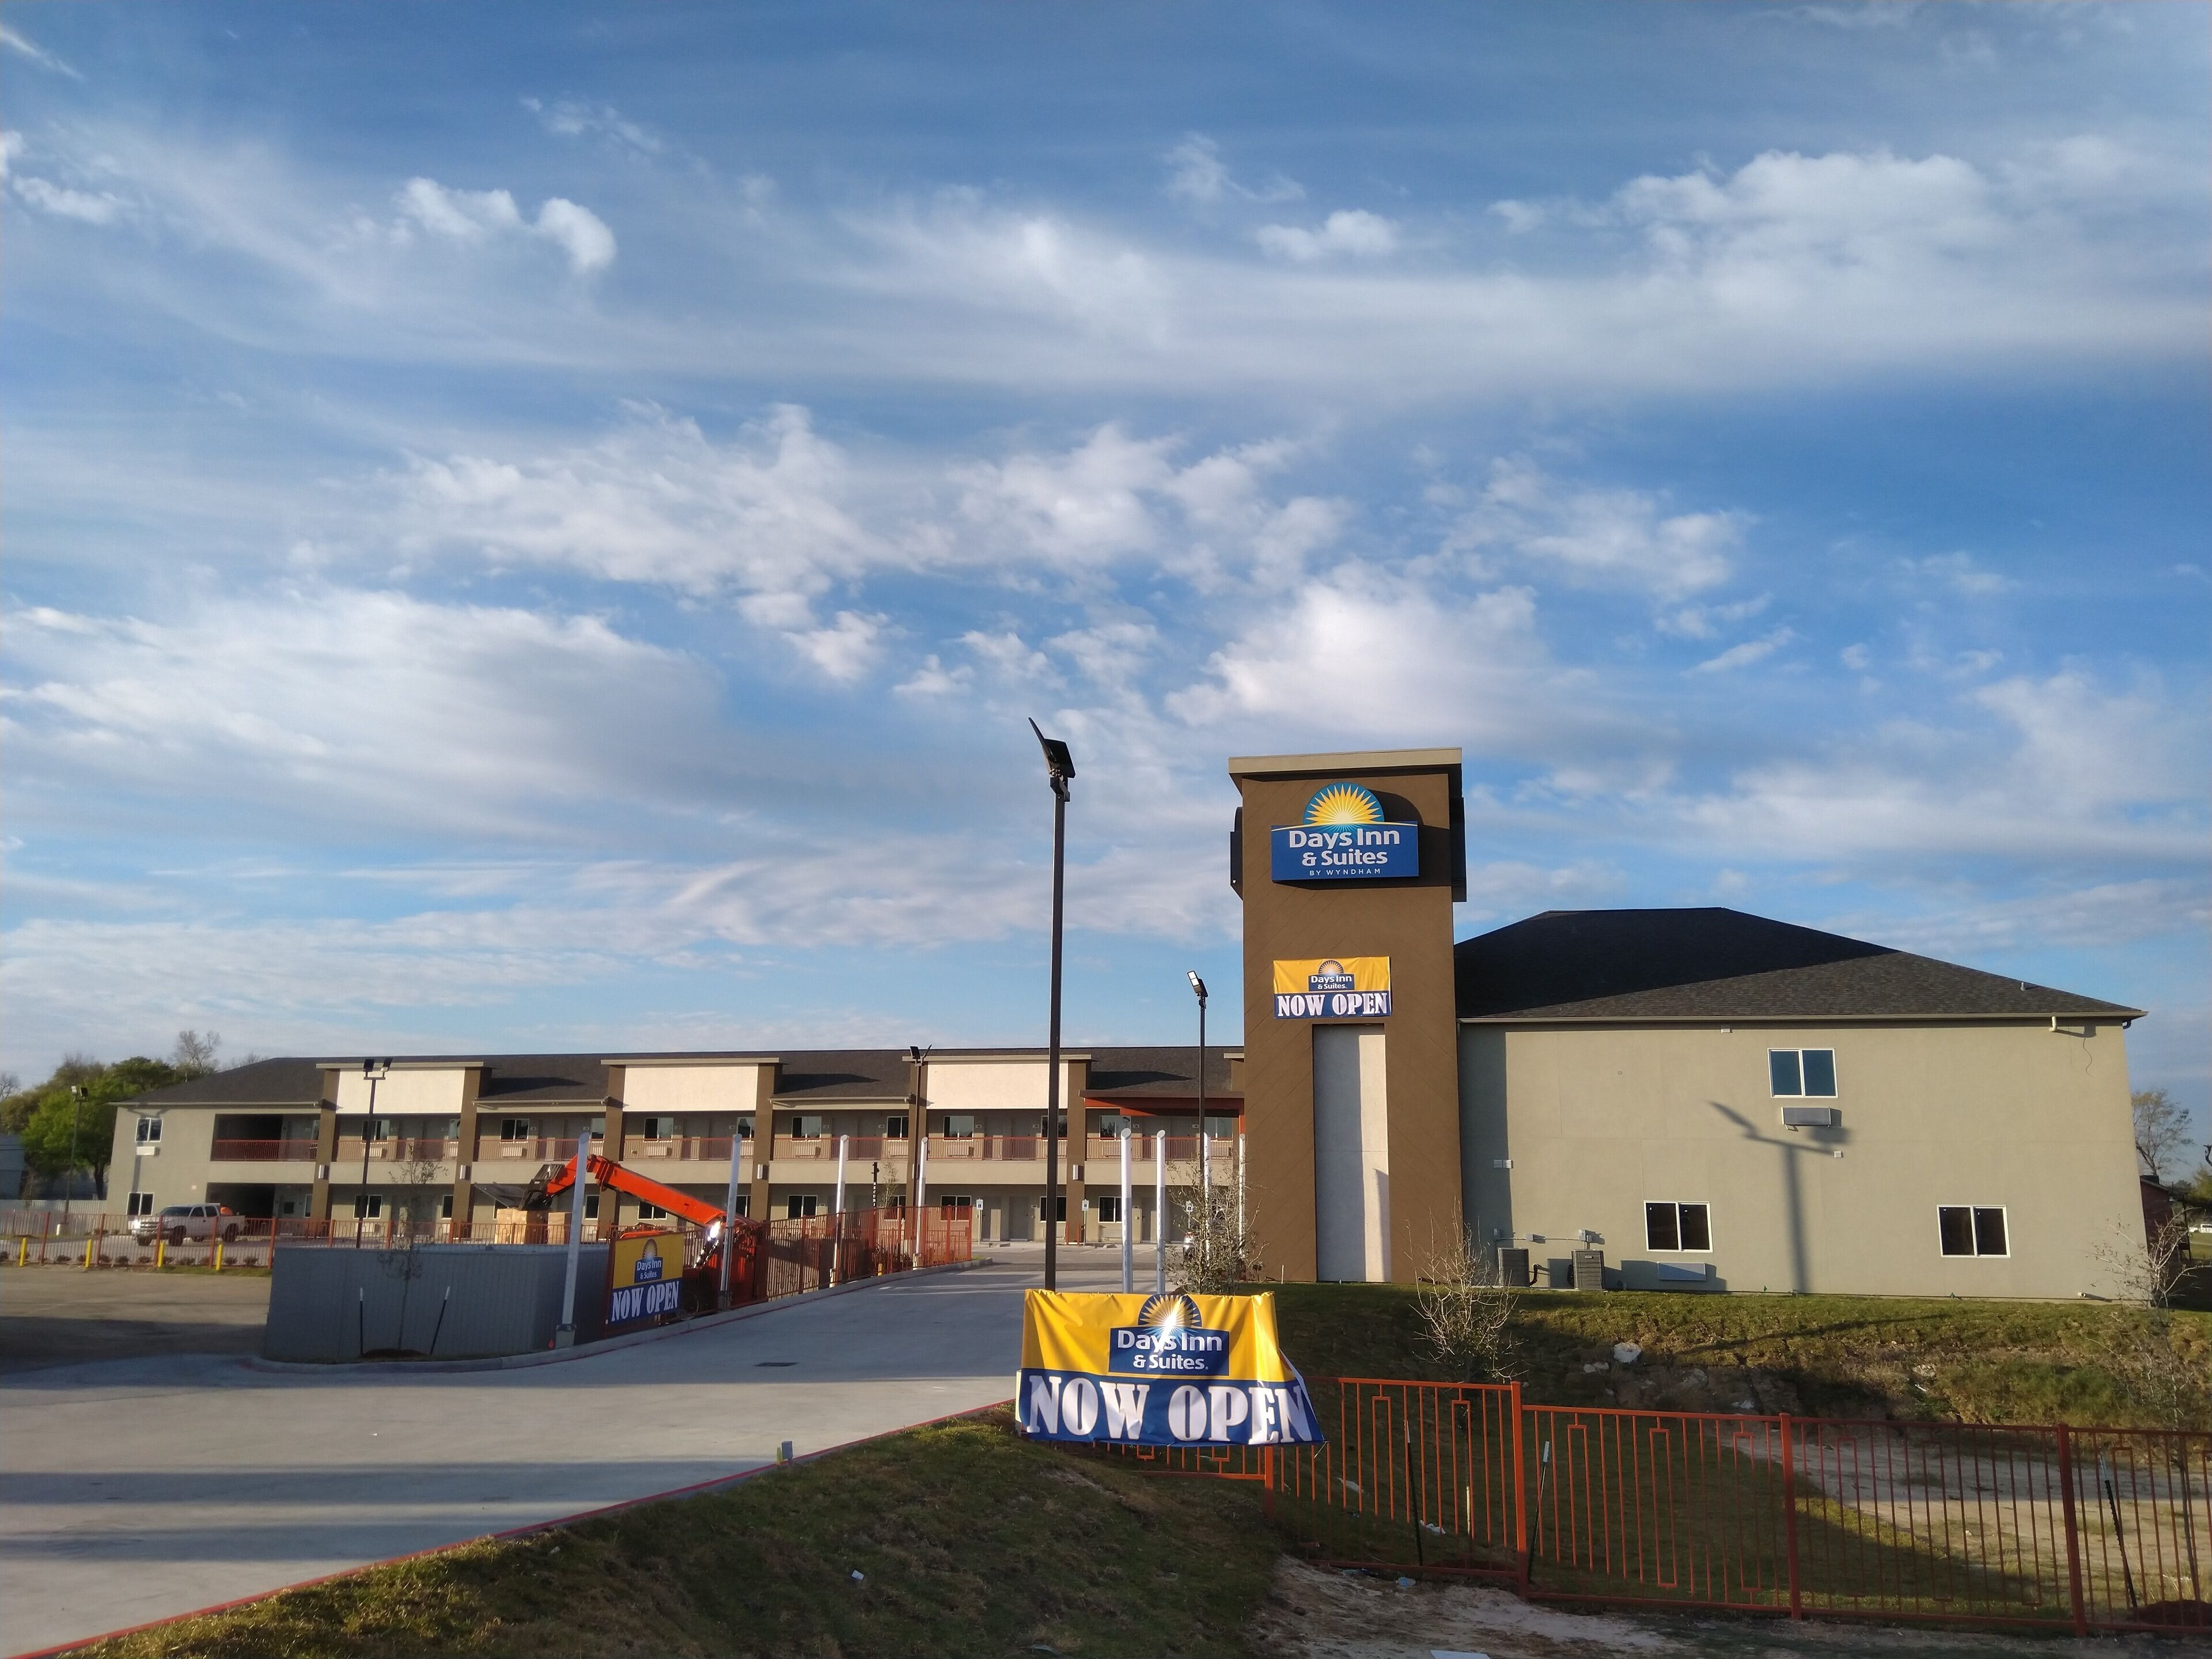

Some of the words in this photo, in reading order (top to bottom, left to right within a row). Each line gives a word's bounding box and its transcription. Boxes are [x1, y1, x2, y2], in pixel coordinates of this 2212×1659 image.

[1289, 830, 1352, 849] Days
[1357, 828, 1400, 846] Inn
[1302, 851, 1316, 866] &
[1321, 849, 1388, 865] Suites
[1310, 975, 1335, 983] Days
[1277, 994, 1325, 1016] NOW
[1332, 993, 1388, 1016] OPEN
[637, 1260, 652, 1271] Days
[652, 1260, 662, 1268] Inn
[643, 1271, 657, 1279] Suites
[611, 1287, 644, 1321] NOW
[646, 1281, 679, 1314] OPEN
[1117, 1330, 1177, 1354] Days
[1181, 1332, 1222, 1352] Inn
[1133, 1354, 1146, 1368] &
[1149, 1354, 1205, 1370] Suites
[1027, 1374, 1150, 1440] NOW
[1168, 1384, 1313, 1445] OPEN
